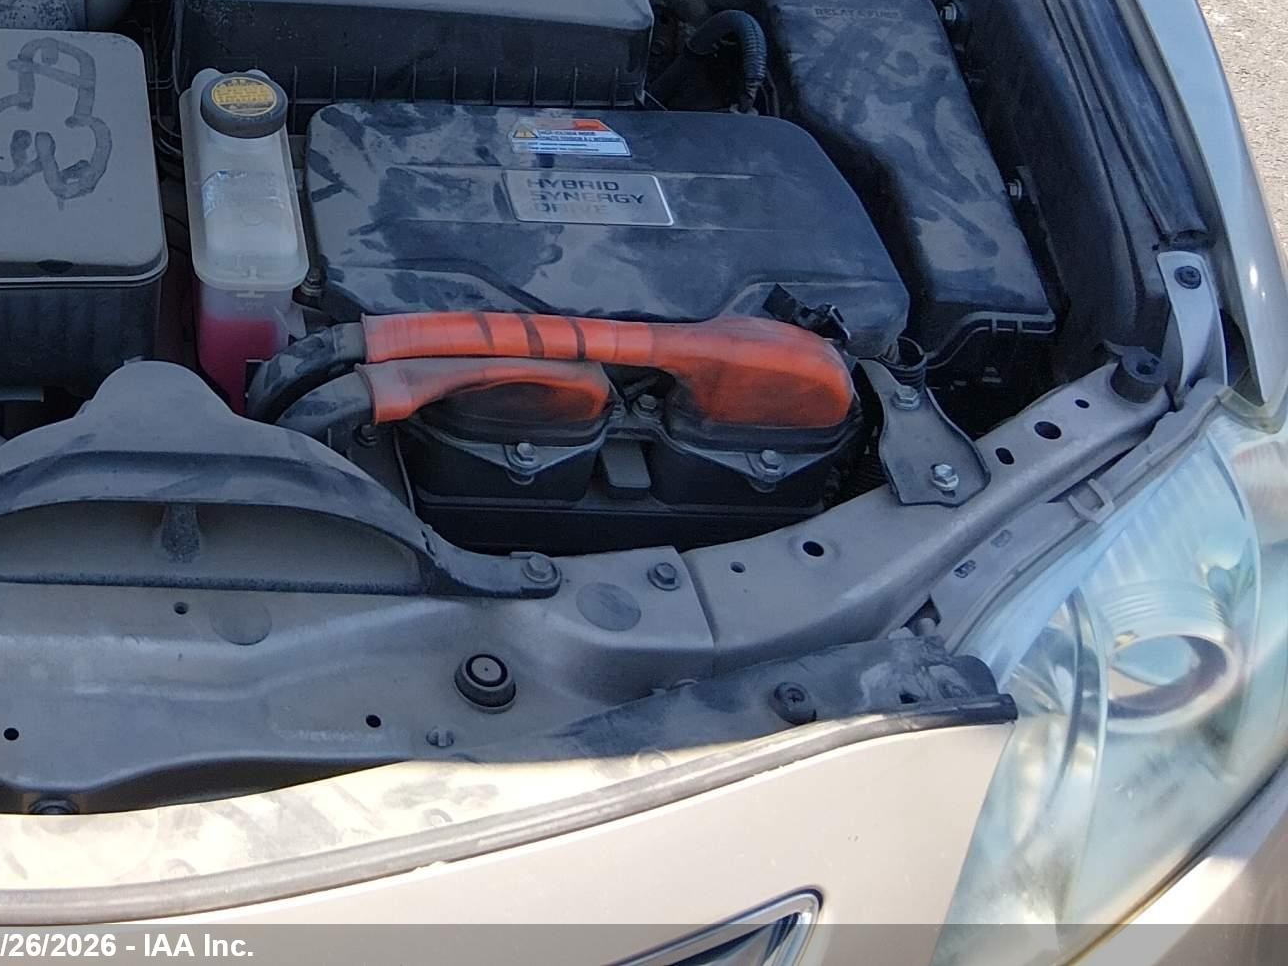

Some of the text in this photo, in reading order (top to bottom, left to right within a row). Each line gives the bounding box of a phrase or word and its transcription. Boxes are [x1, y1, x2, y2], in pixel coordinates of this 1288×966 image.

[527, 178, 620, 192] HYBRID
[530, 191, 646, 205] SYNERGY
[534, 203, 610, 215] DRIVE
